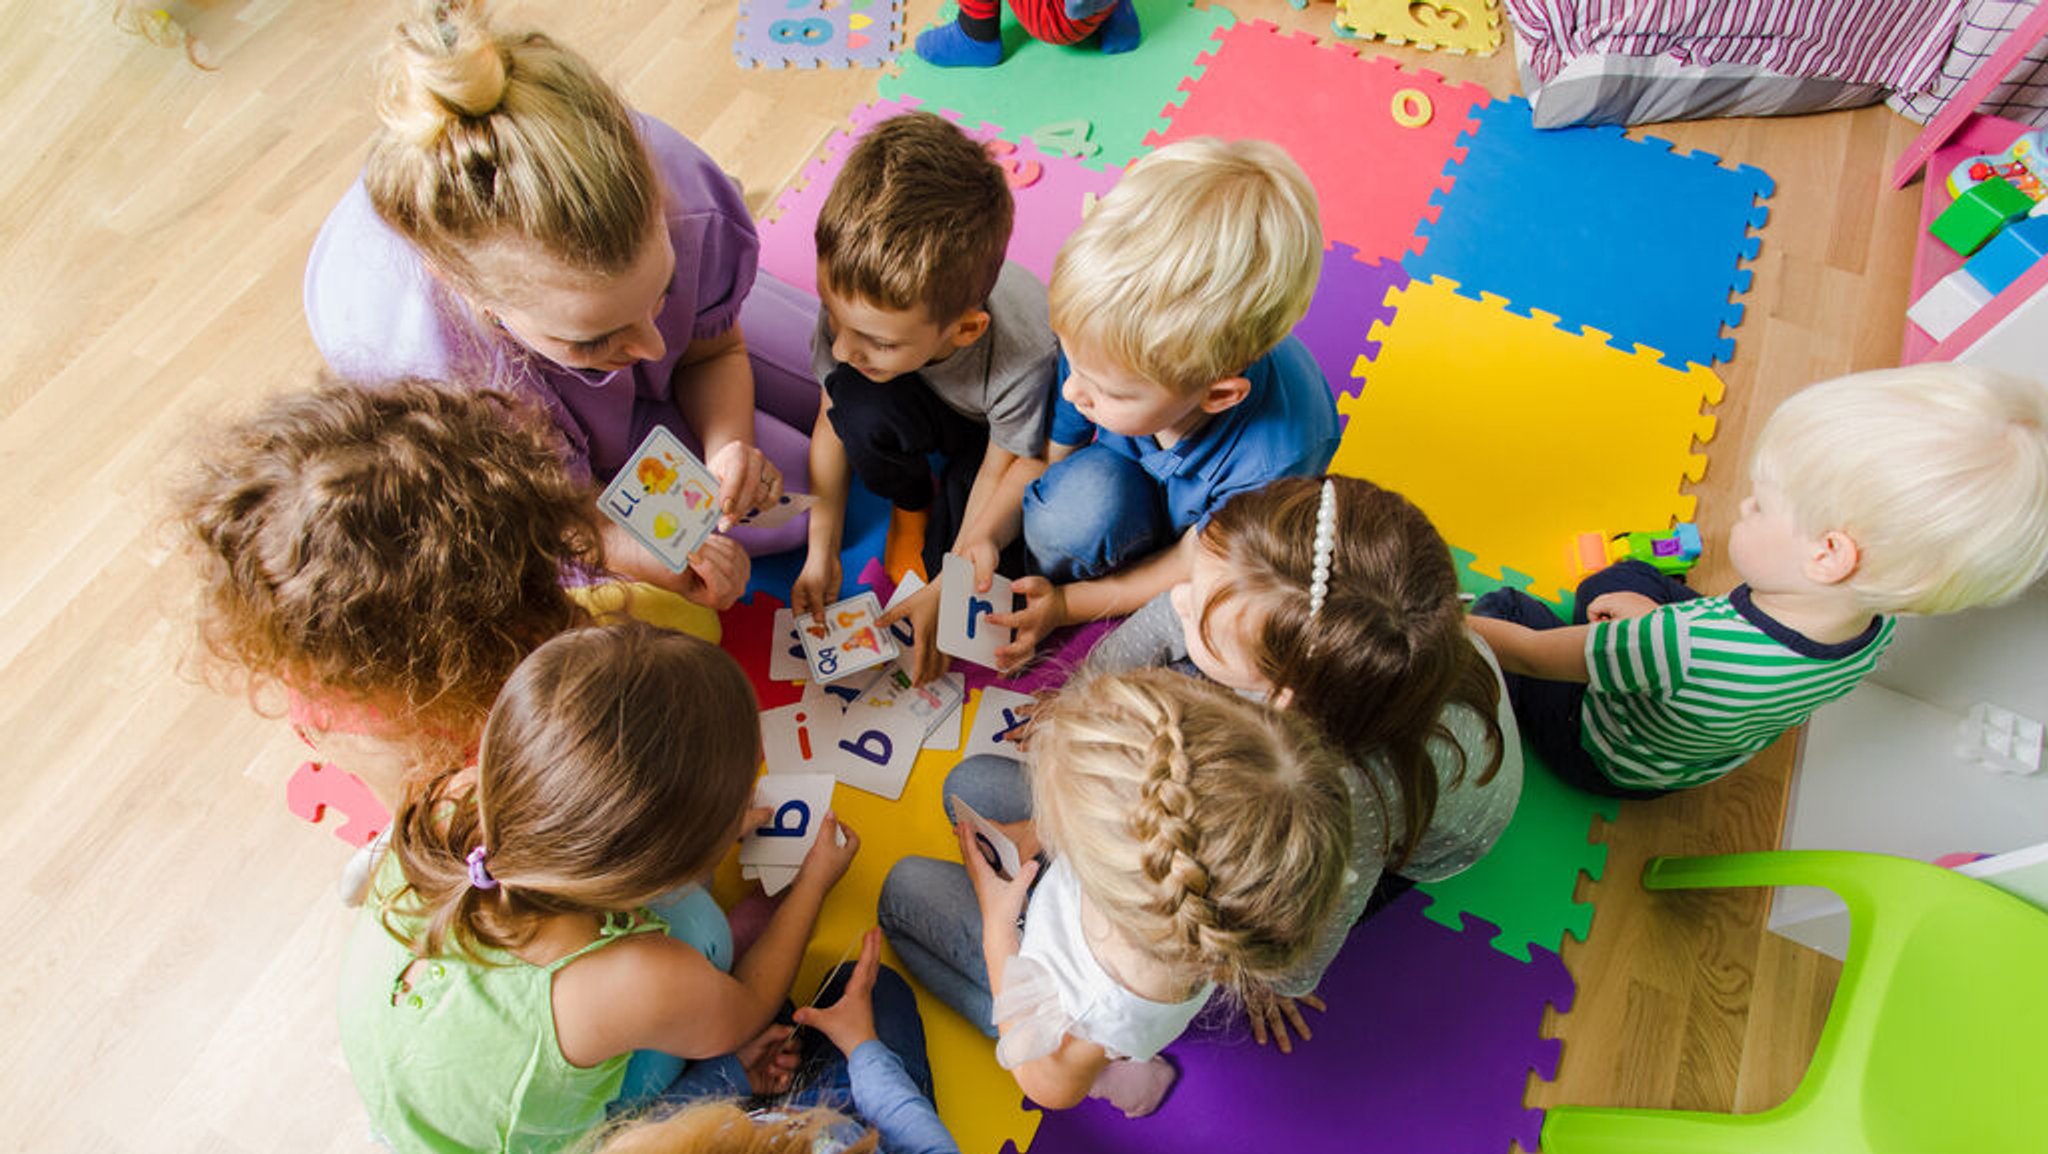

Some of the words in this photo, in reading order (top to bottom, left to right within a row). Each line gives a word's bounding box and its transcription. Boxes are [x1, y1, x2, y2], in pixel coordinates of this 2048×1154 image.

[768, 17, 833, 46] 8
[967, 596, 993, 639] r
[795, 712, 813, 762] i
